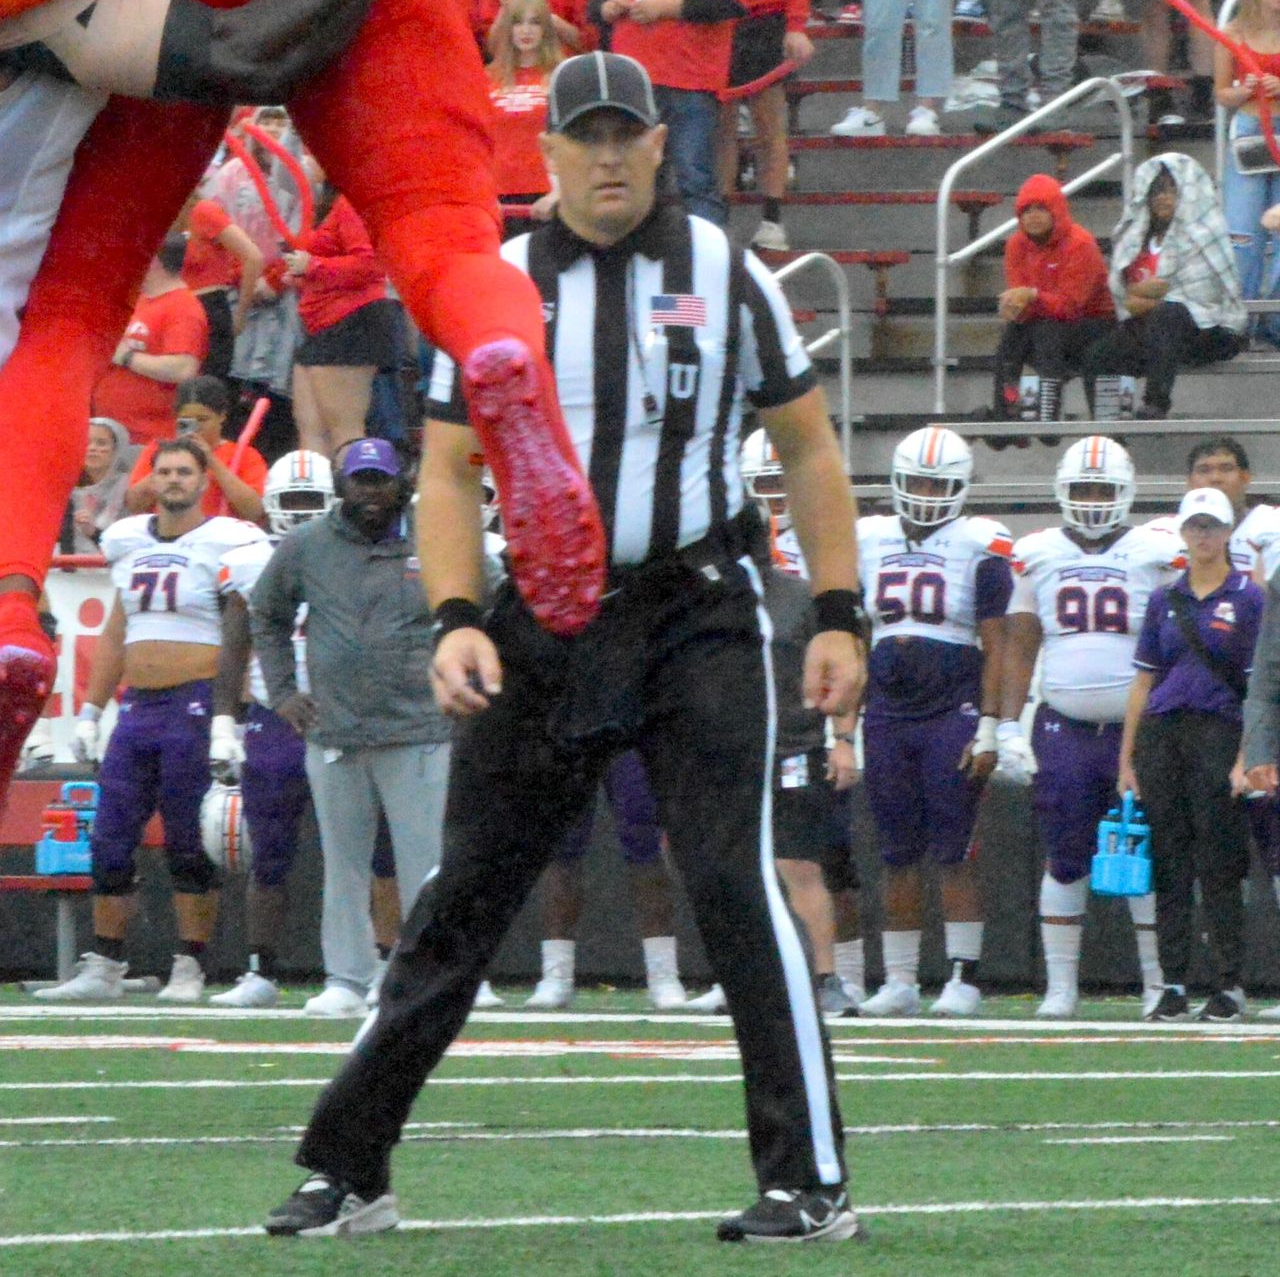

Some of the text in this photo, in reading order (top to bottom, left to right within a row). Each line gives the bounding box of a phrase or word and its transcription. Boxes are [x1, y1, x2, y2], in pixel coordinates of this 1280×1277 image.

[670, 363, 699, 398] U
[129, 571, 179, 613] 71
[875, 571, 947, 625] 50
